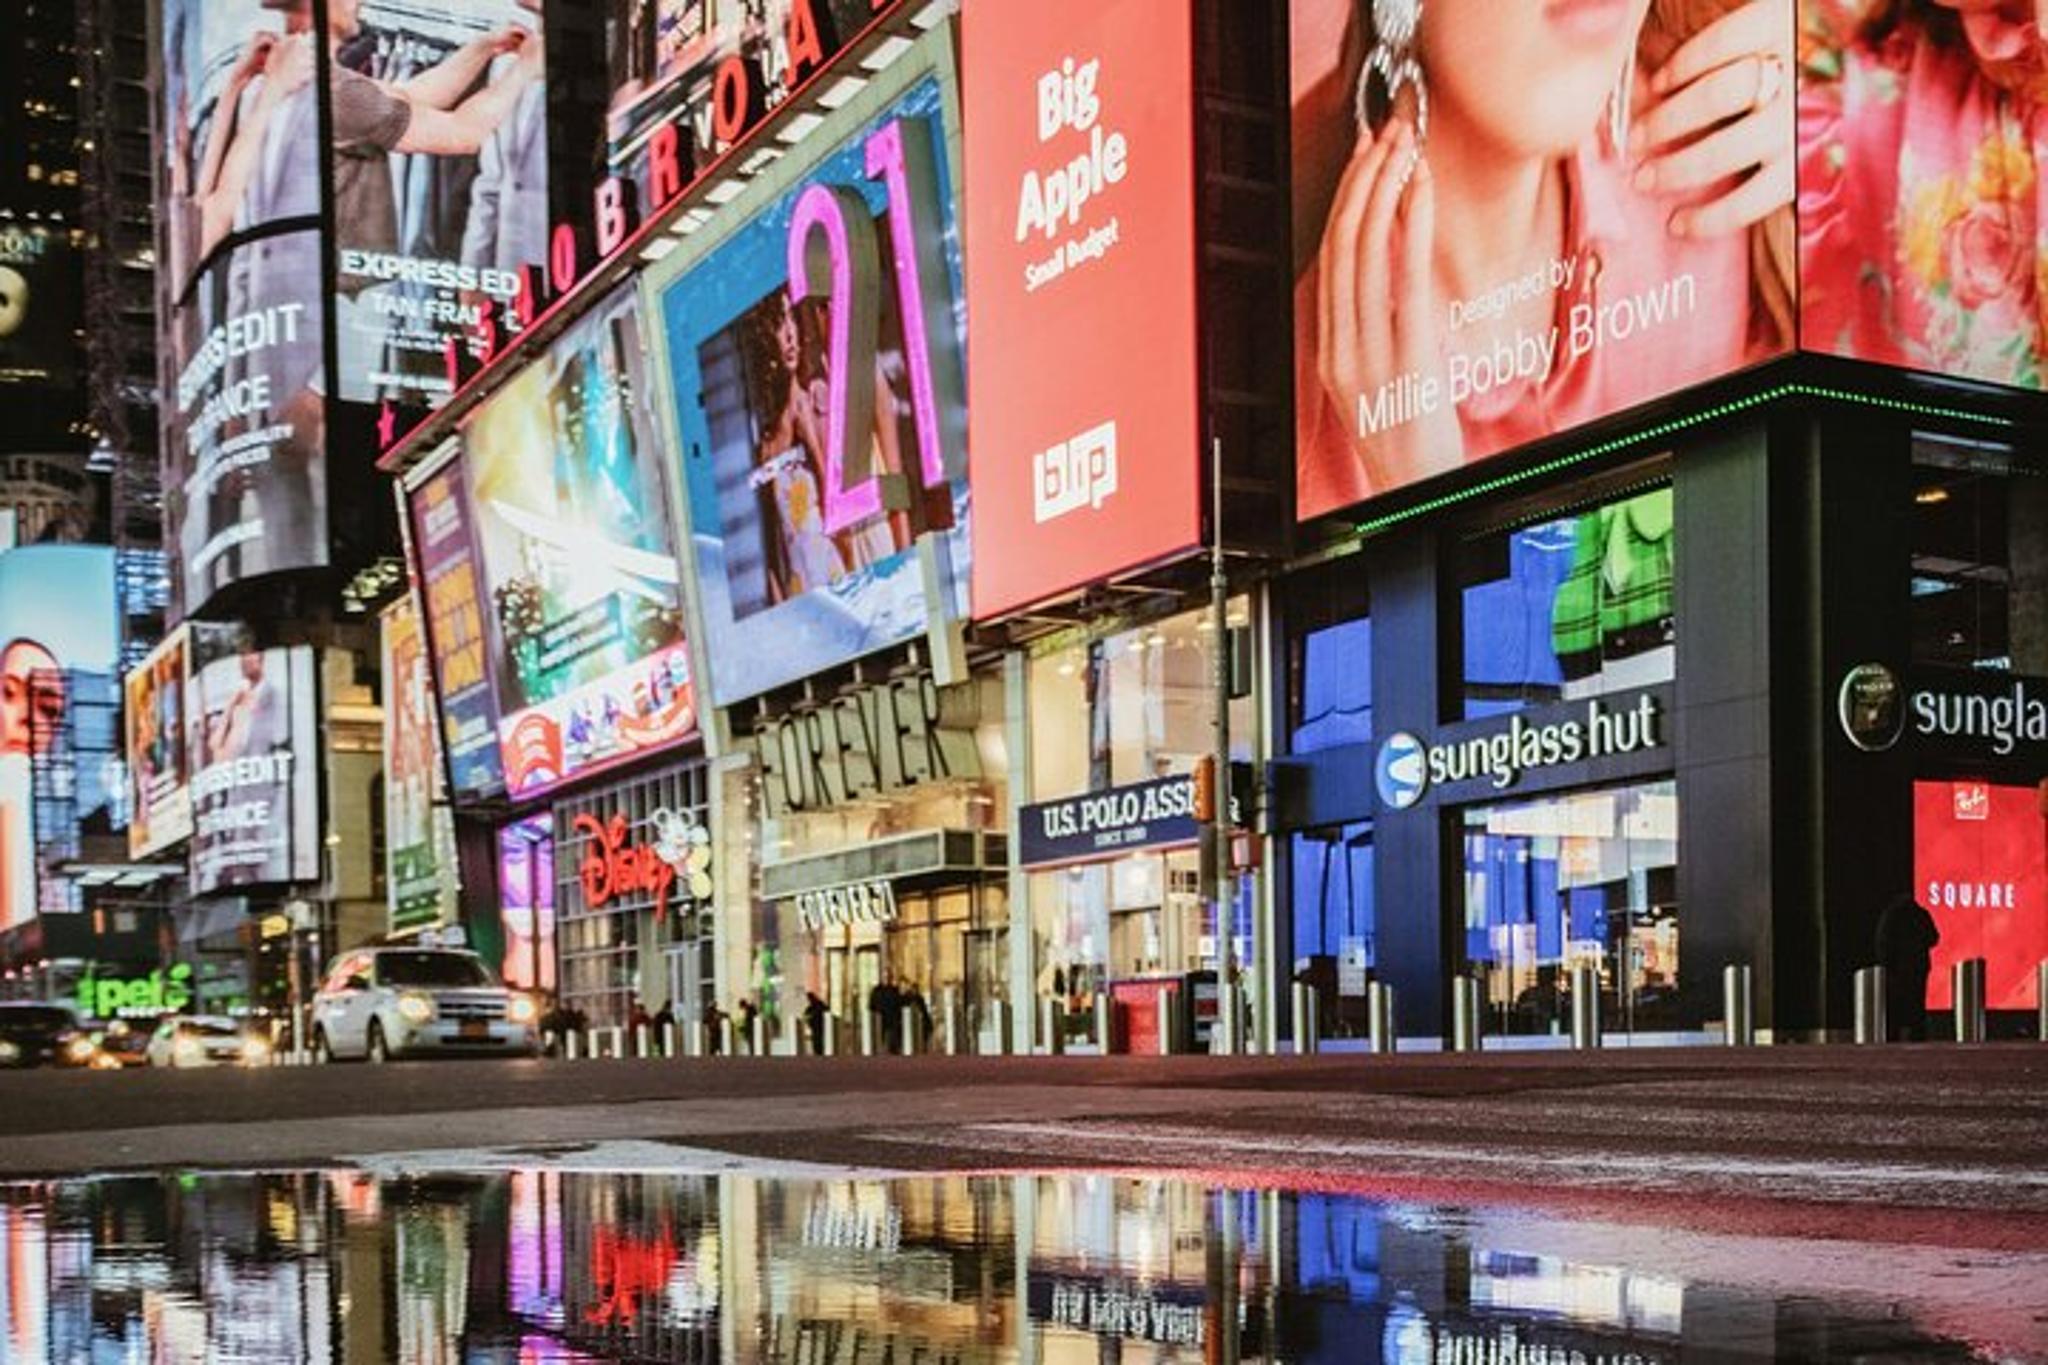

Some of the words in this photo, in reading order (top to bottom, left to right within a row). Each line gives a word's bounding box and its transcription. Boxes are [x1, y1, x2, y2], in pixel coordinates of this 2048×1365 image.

[1038, 57, 1101, 141] Big
[1015, 123, 1128, 243] Apple
[340, 250, 477, 291] EXPRESS
[1024, 246, 1065, 292] Small
[1066, 217, 1119, 268] Budget
[1450, 271, 1546, 330] Designed
[1550, 254, 1578, 291] by
[227, 303, 304, 357] EDIT
[373, 292, 418, 318] TAN
[787, 117, 944, 537] 21
[1357, 369, 1439, 438] Millie
[1450, 325, 1559, 404] Bobby
[1570, 272, 1696, 357] Brown
[753, 667, 952, 820] FOREVER
[1428, 714, 1582, 788] sunglass
[1588, 693, 1657, 757] hut
[1042, 805, 1079, 839] U.S.
[1080, 792, 1139, 832] POLO
[1928, 880, 2016, 909] SQUARE
